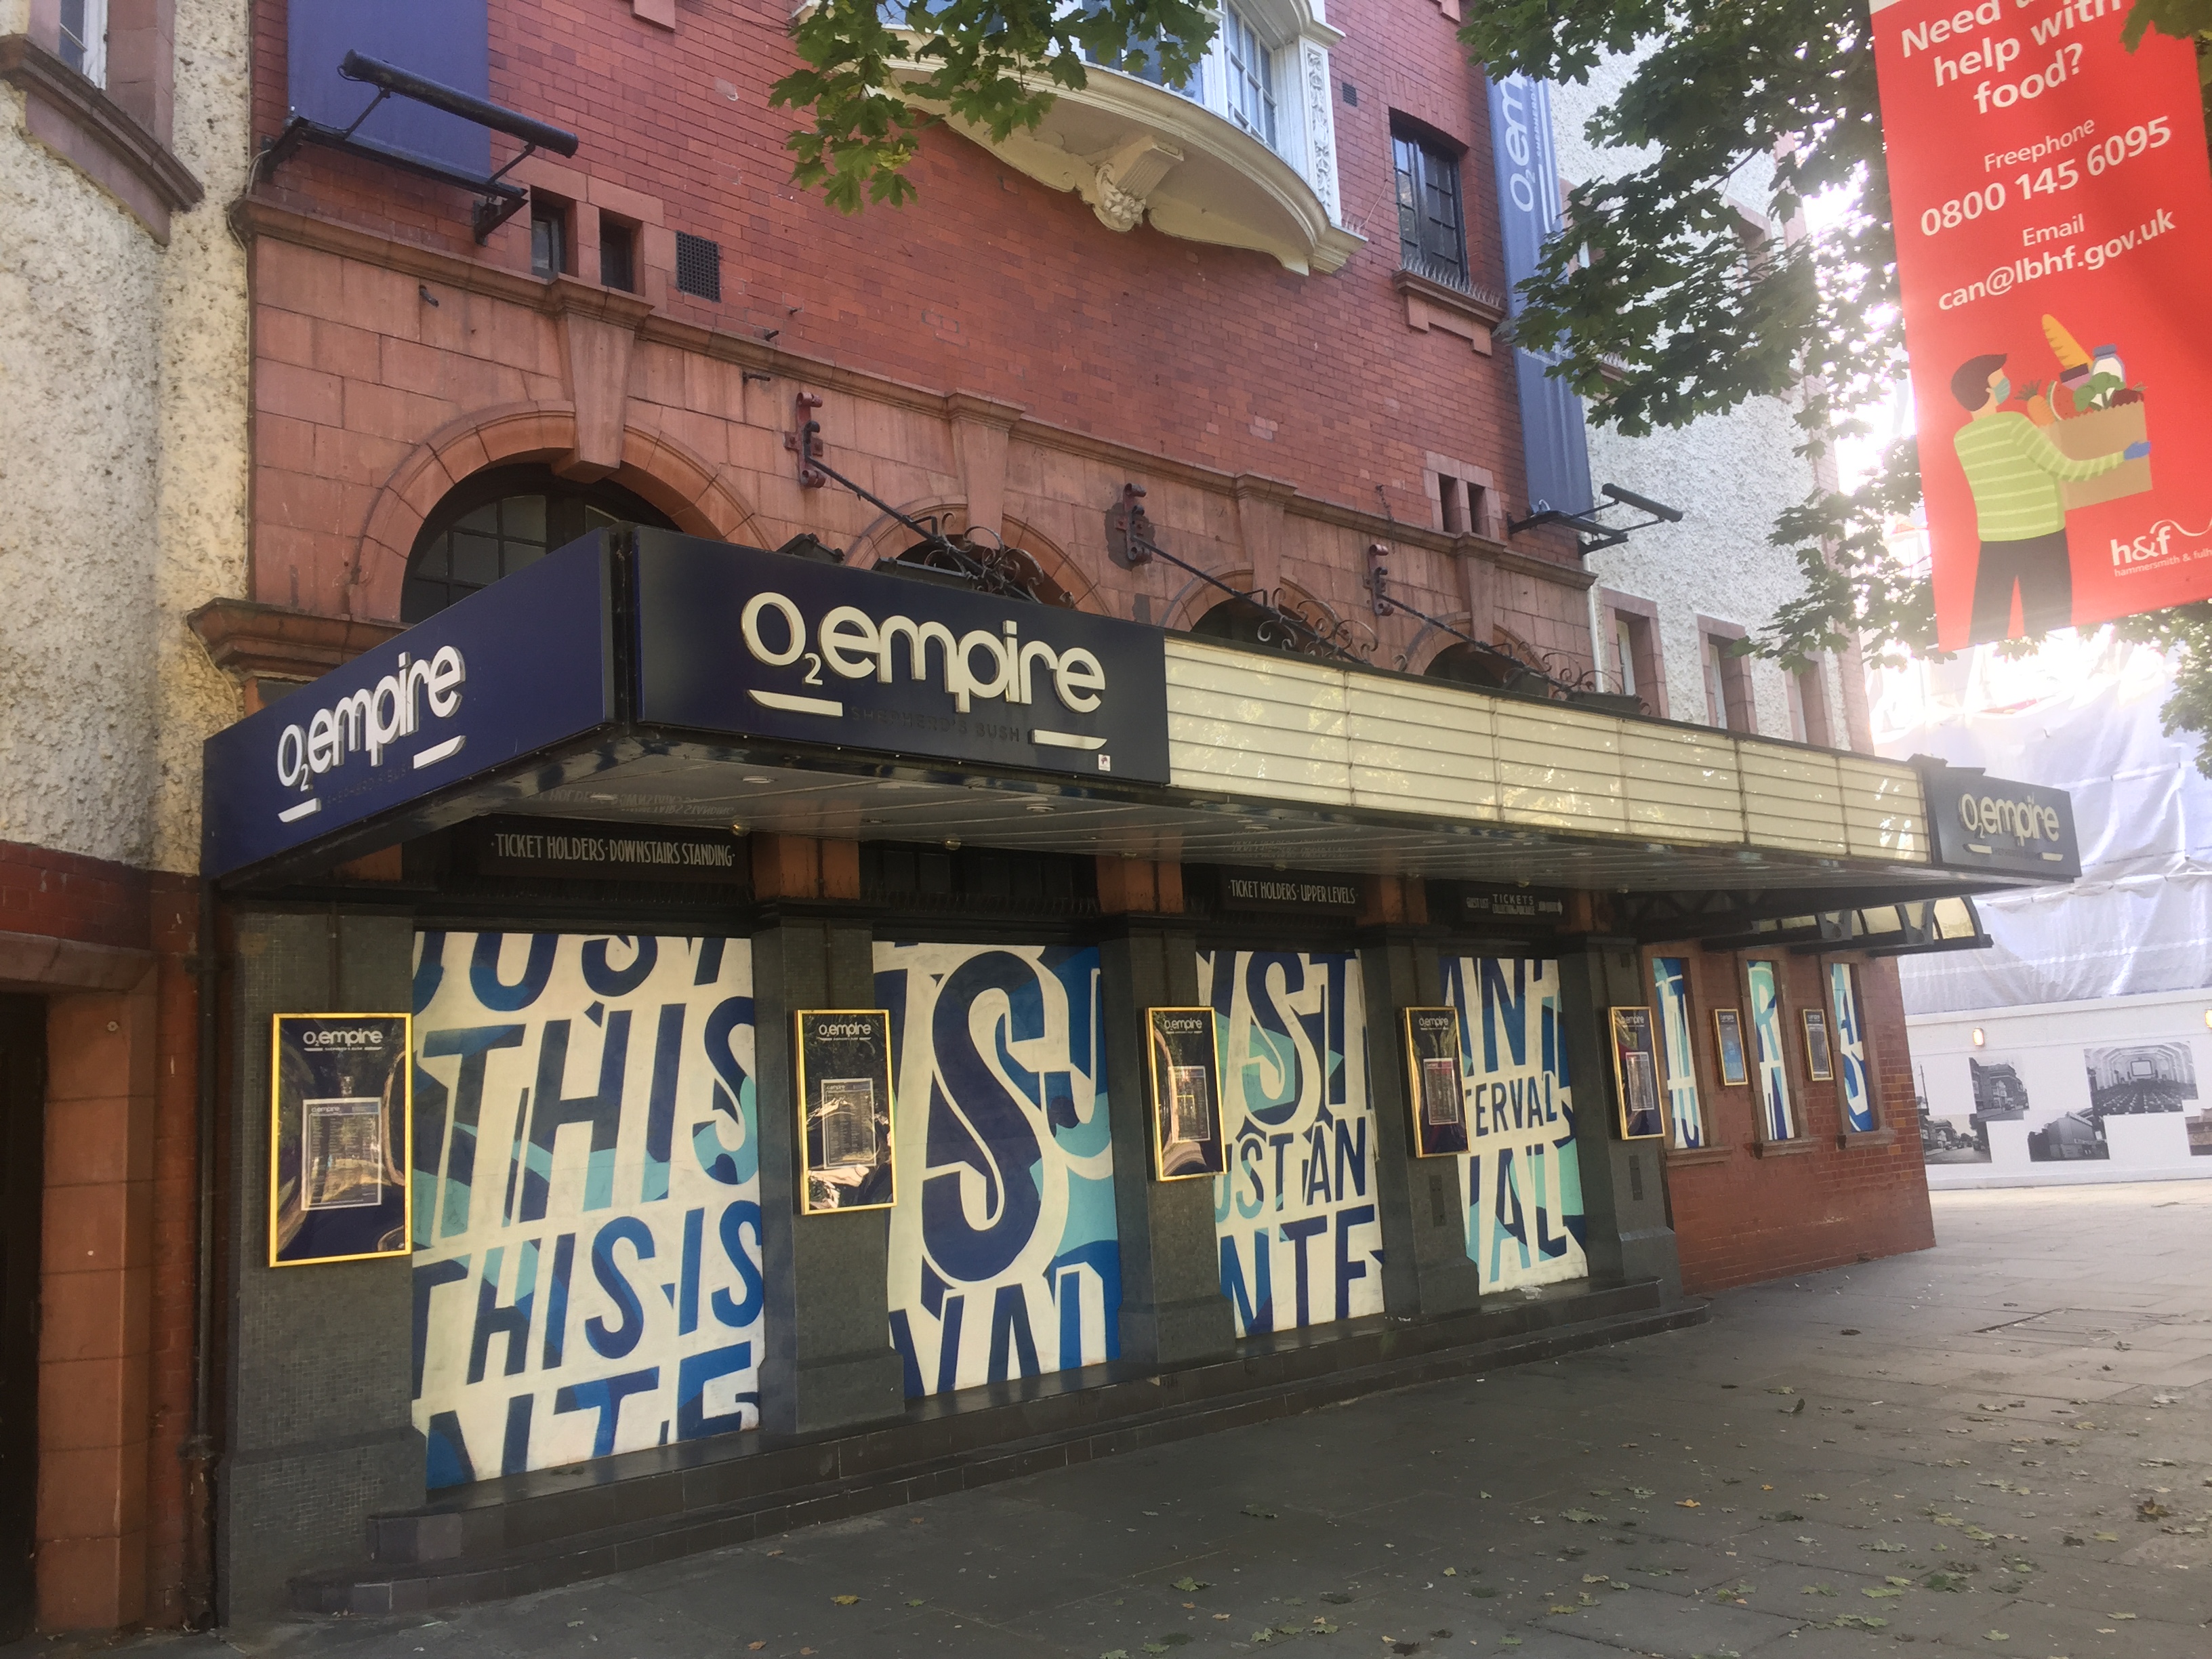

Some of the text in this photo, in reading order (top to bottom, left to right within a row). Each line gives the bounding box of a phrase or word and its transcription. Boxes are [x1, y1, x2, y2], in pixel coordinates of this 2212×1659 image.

[1901, 0, 2001, 58] Need
[1933, 38, 2020, 87] help
[1973, 43, 2083, 114] food?
[1984, 119, 2095, 172] Freephone
[1921, 116, 2171, 236] 0800 145 6095
[2022, 213, 2085, 247] Email
[1939, 208, 2175, 310] can@lbhf.gov.uk
[2110, 525, 2171, 566] h&f
[2114, 554, 2180, 577] hammersmith
[2182, 553, 2191, 562] &
[977, 724, 1019, 742] BUSH
[495, 833, 732, 867] TICKET HOLDERS DOWNSTAIRS STANDING
[1230, 880, 1355, 904] TICKET HOLDERS UPPER LEVELS
[1493, 894, 1534, 905] TICKETS
[423, 996, 759, 1239] THIS
[679, 1200, 764, 1337] IS
